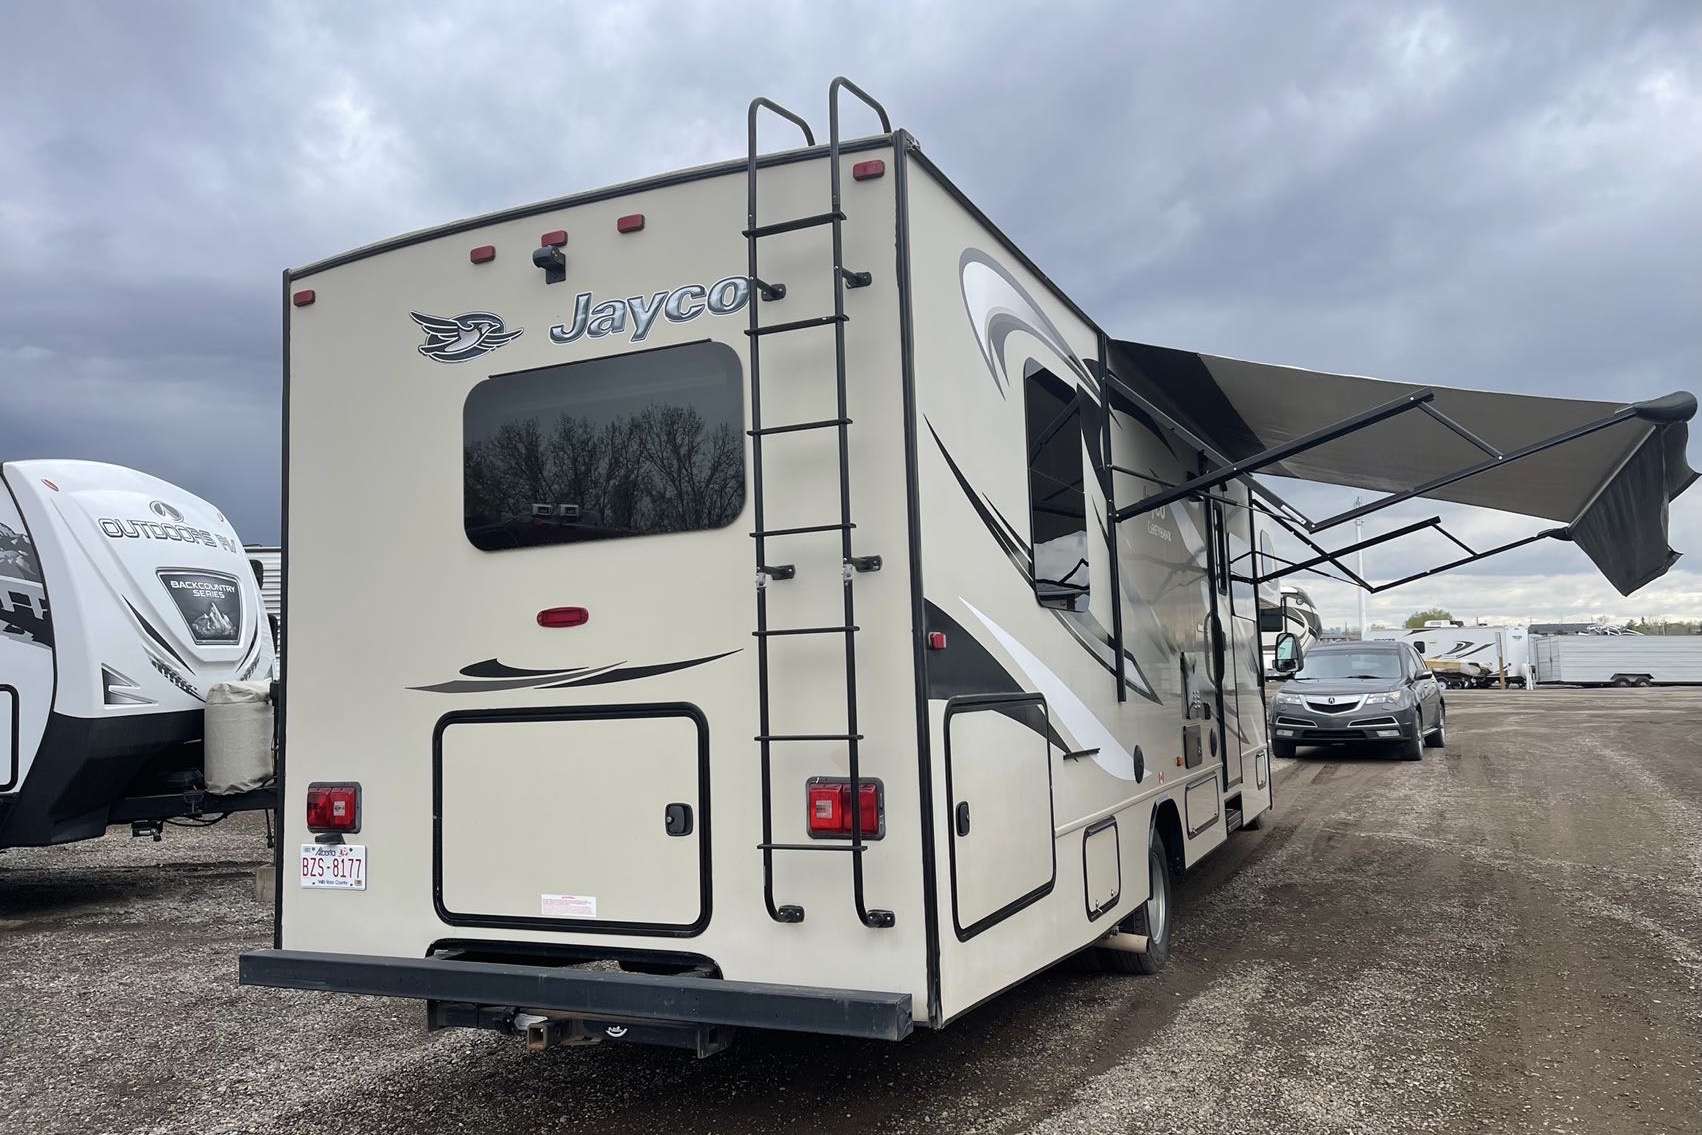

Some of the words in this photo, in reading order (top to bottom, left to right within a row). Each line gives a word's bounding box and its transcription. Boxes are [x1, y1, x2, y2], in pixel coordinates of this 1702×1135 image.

[550, 276, 749, 344] Jayco
[98, 518, 217, 547] OUTDOORS
[215, 533, 236, 553] RV
[170, 580, 235, 593] BACKCOUNTRY
[192, 589, 225, 599] SERIES
[302, 857, 361, 878] BZS-8177
